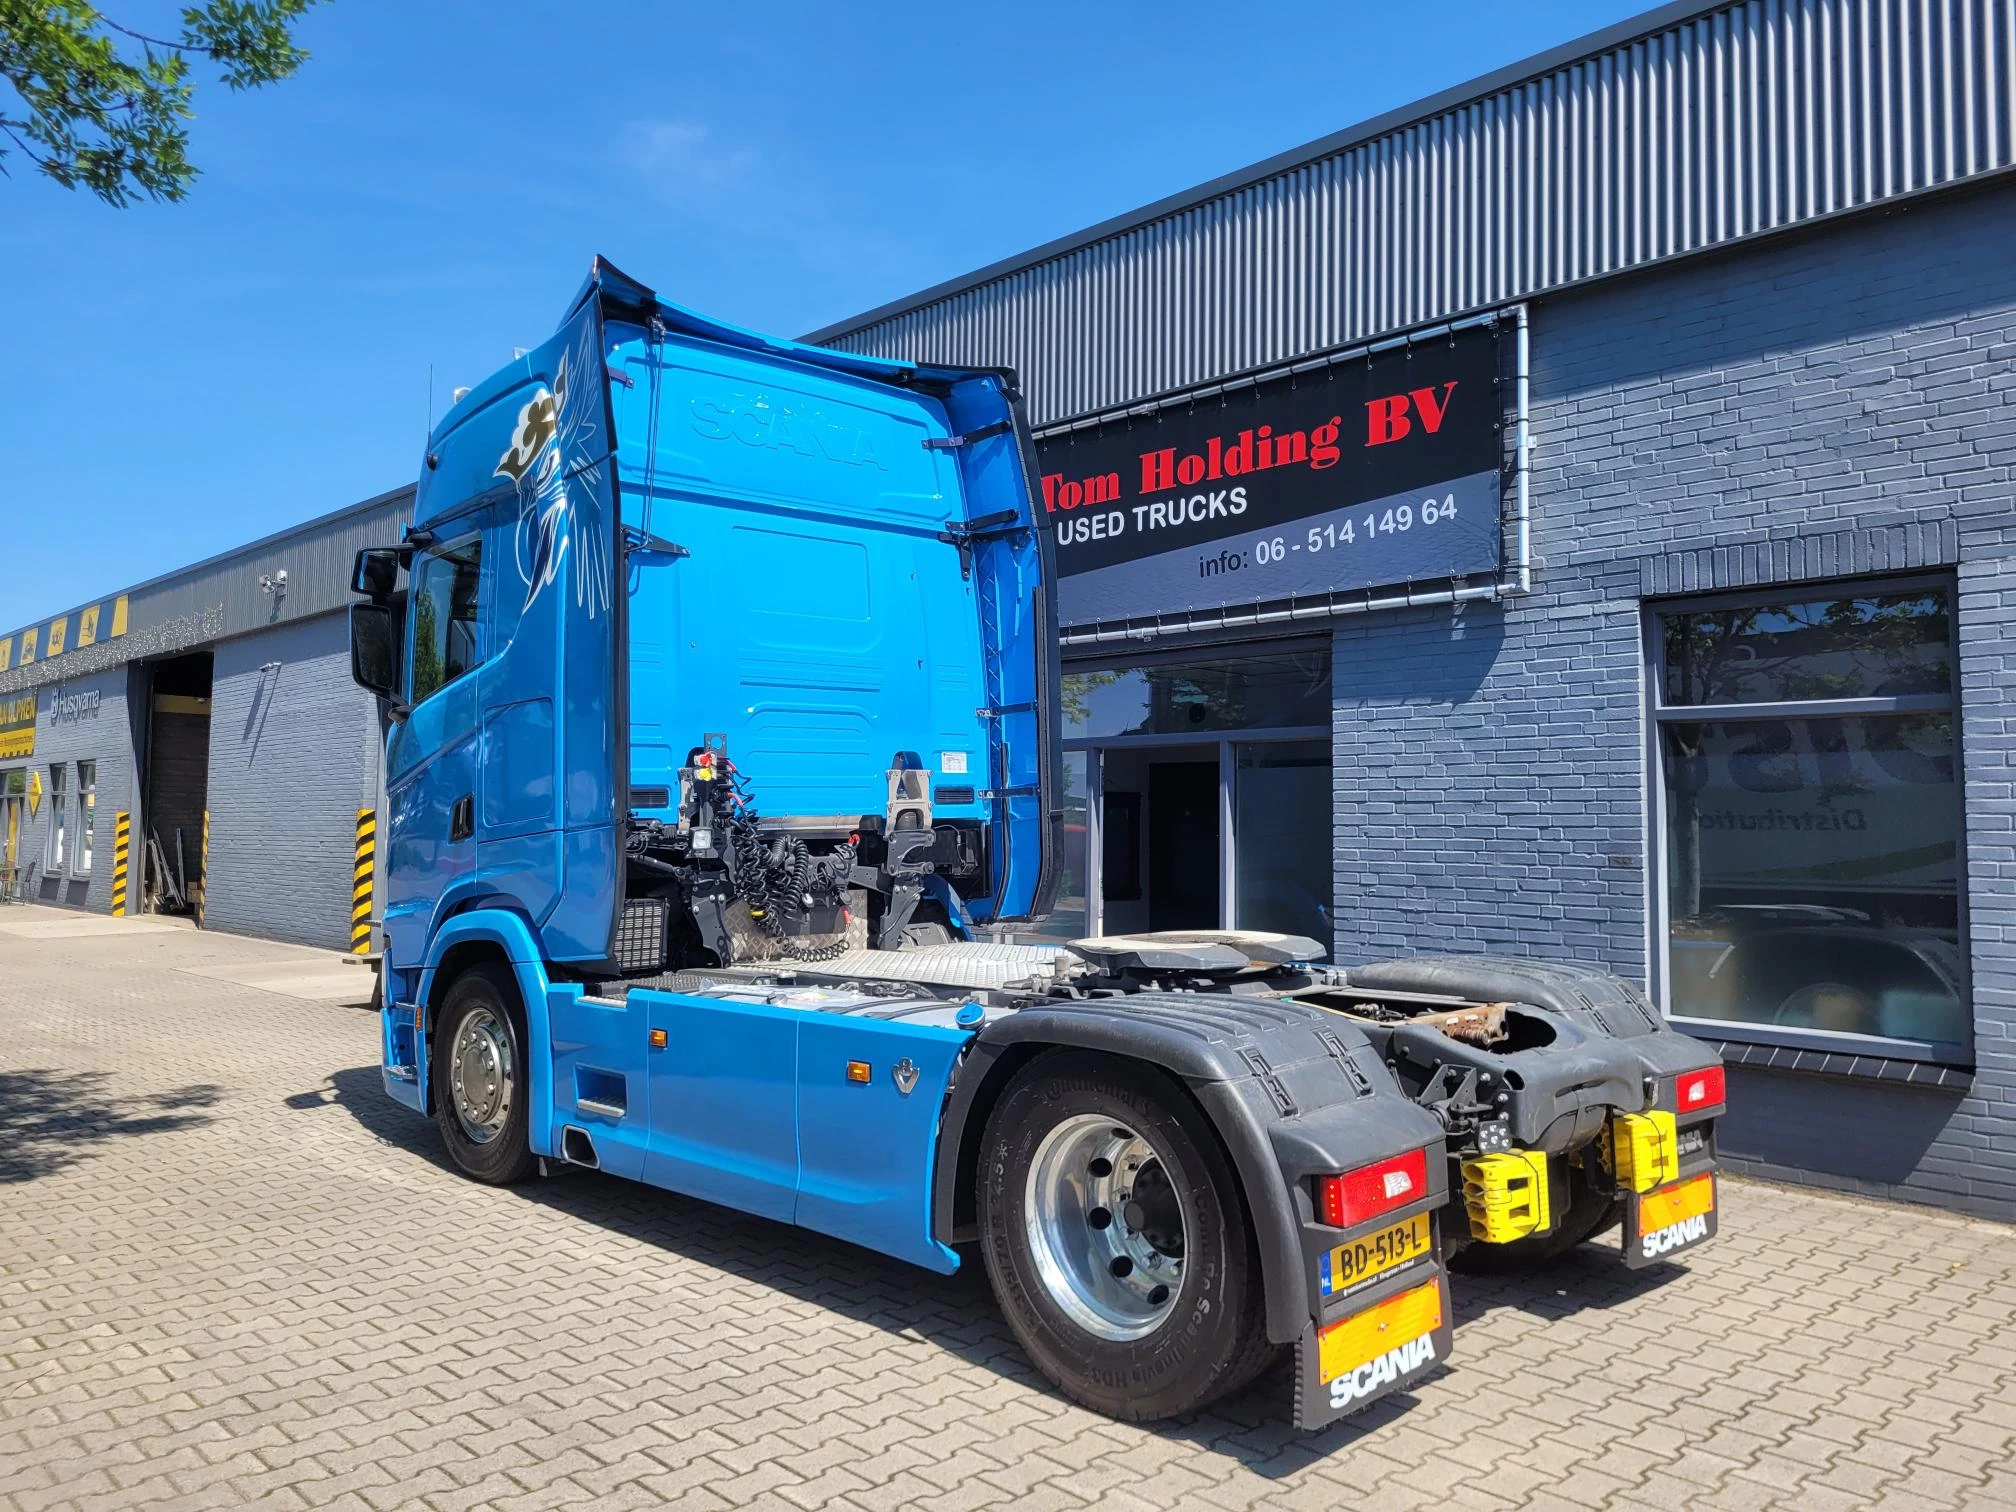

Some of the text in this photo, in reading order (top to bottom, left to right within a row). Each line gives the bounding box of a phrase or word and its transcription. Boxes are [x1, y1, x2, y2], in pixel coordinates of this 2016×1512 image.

[1041, 381, 1458, 512] Tom Holding BV
[1058, 487, 1248, 546] USED TRUCKS
[1199, 551, 1248, 578] info:
[1255, 537, 1286, 565] 06
[1308, 519, 1356, 552] 514
[1363, 505, 1413, 539] 149
[1421, 494, 1457, 524] 64
[59, 689, 100, 718] Husqvarna
[1341, 1221, 1422, 1282] BD-513-L
[1641, 1213, 1708, 1258] SCANIA
[1321, 1277, 1331, 1289] NL
[1329, 1331, 1436, 1409] SCANIA
